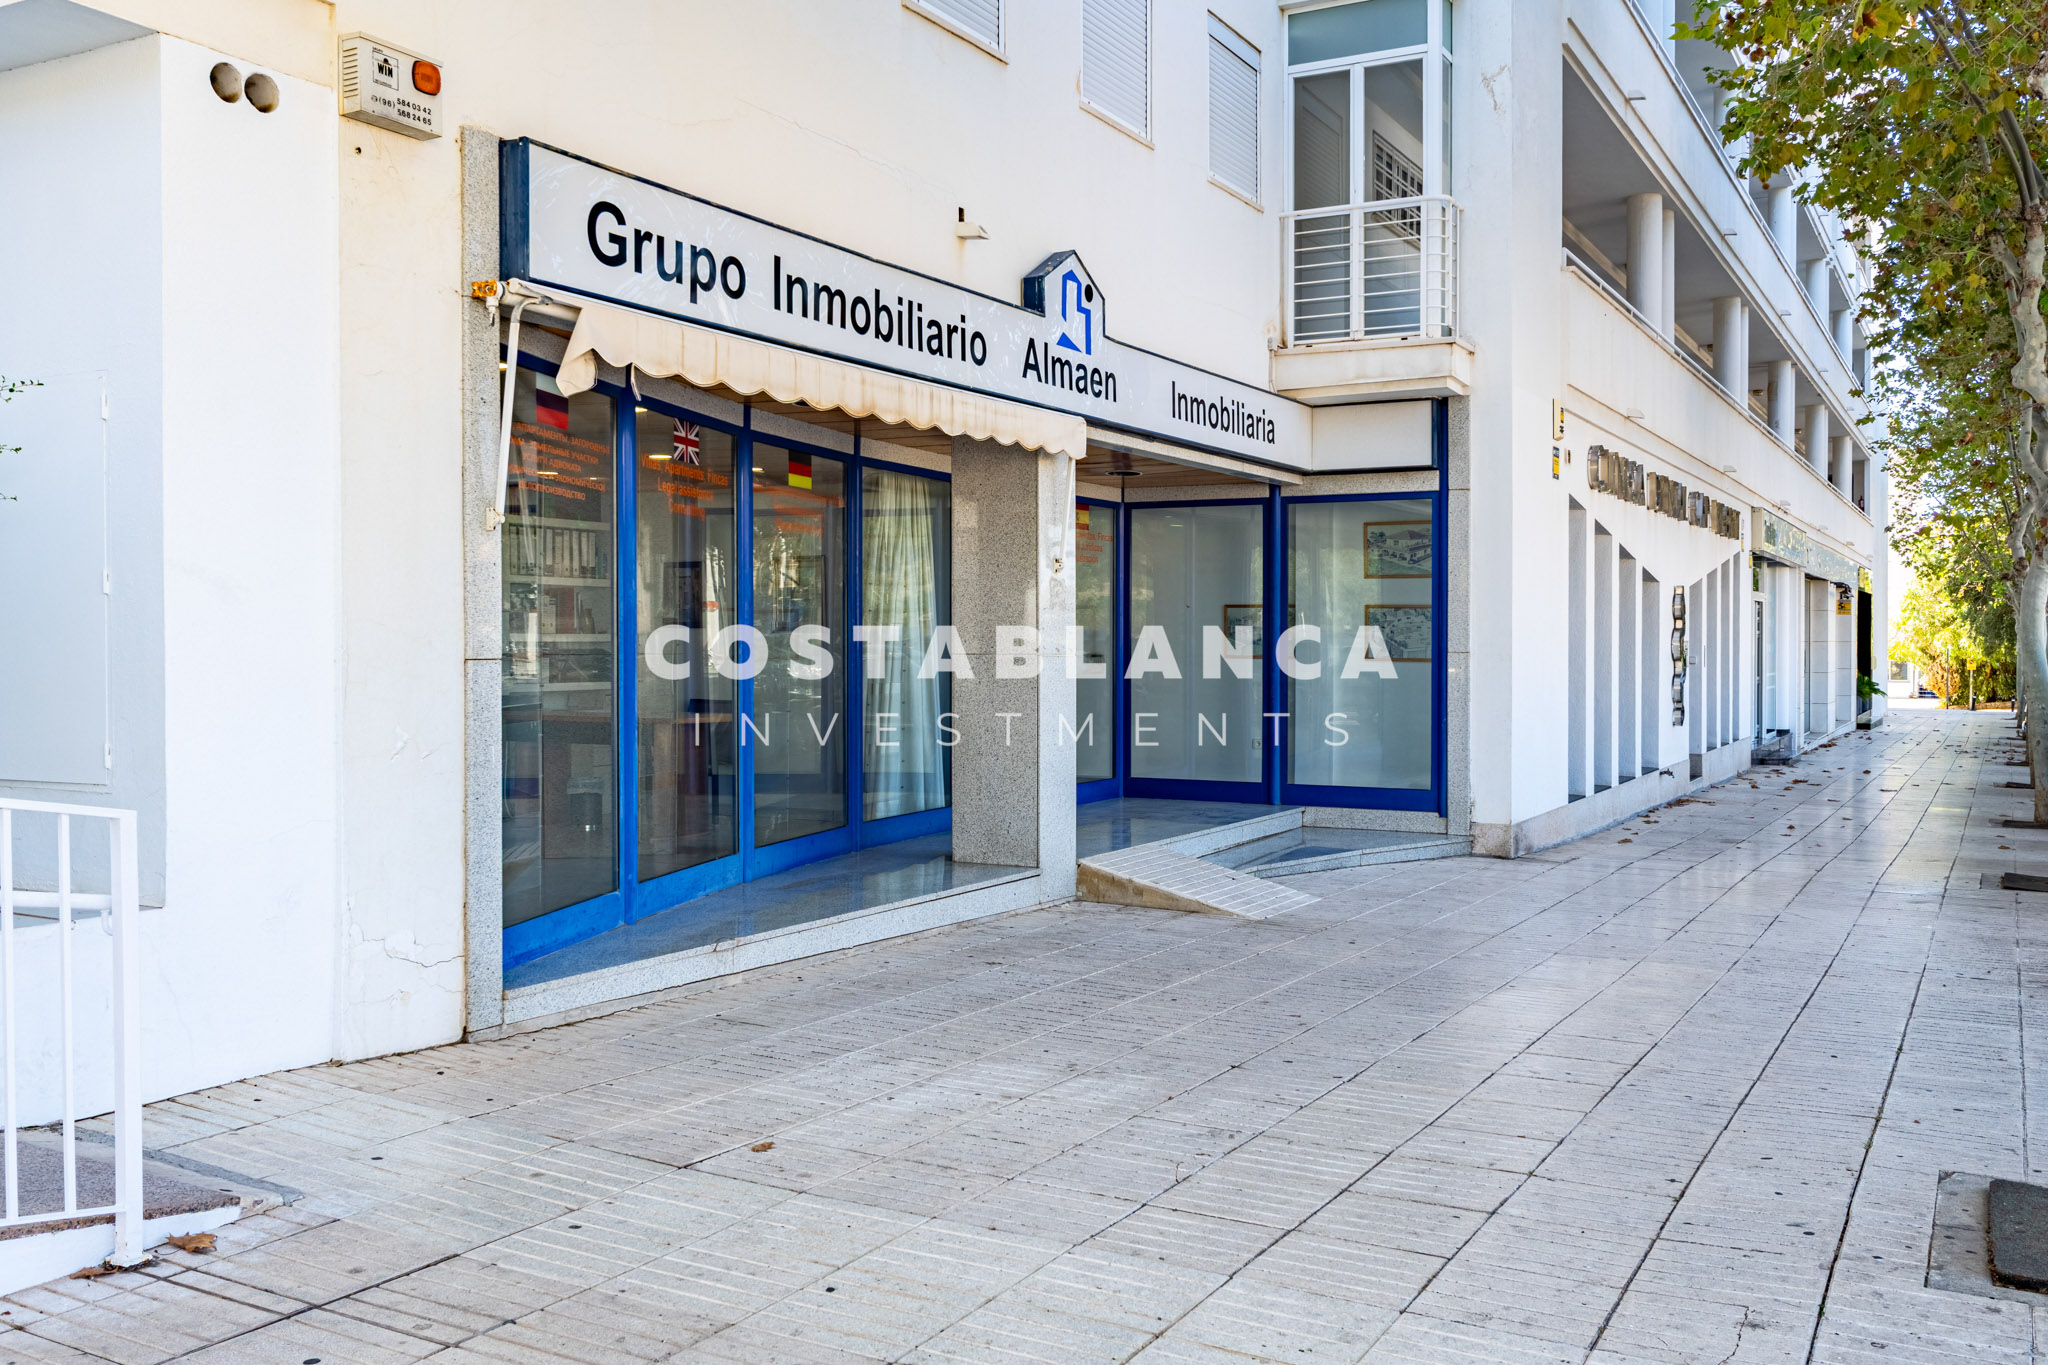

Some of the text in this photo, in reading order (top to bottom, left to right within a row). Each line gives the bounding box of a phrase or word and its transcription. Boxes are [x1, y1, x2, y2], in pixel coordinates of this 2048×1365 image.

[377, 62, 394, 79] WIN
[397, 97, 411, 109] 584
[411, 101, 421, 112] 03
[422, 105, 432, 116] 42
[412, 112, 421, 122] 24
[422, 116, 432, 126] 65
[587, 200, 988, 367] Grupo Inmobiliario
[1022, 337, 1117, 403] Almaen
[1171, 380, 1275, 445] Inmobiliaria
